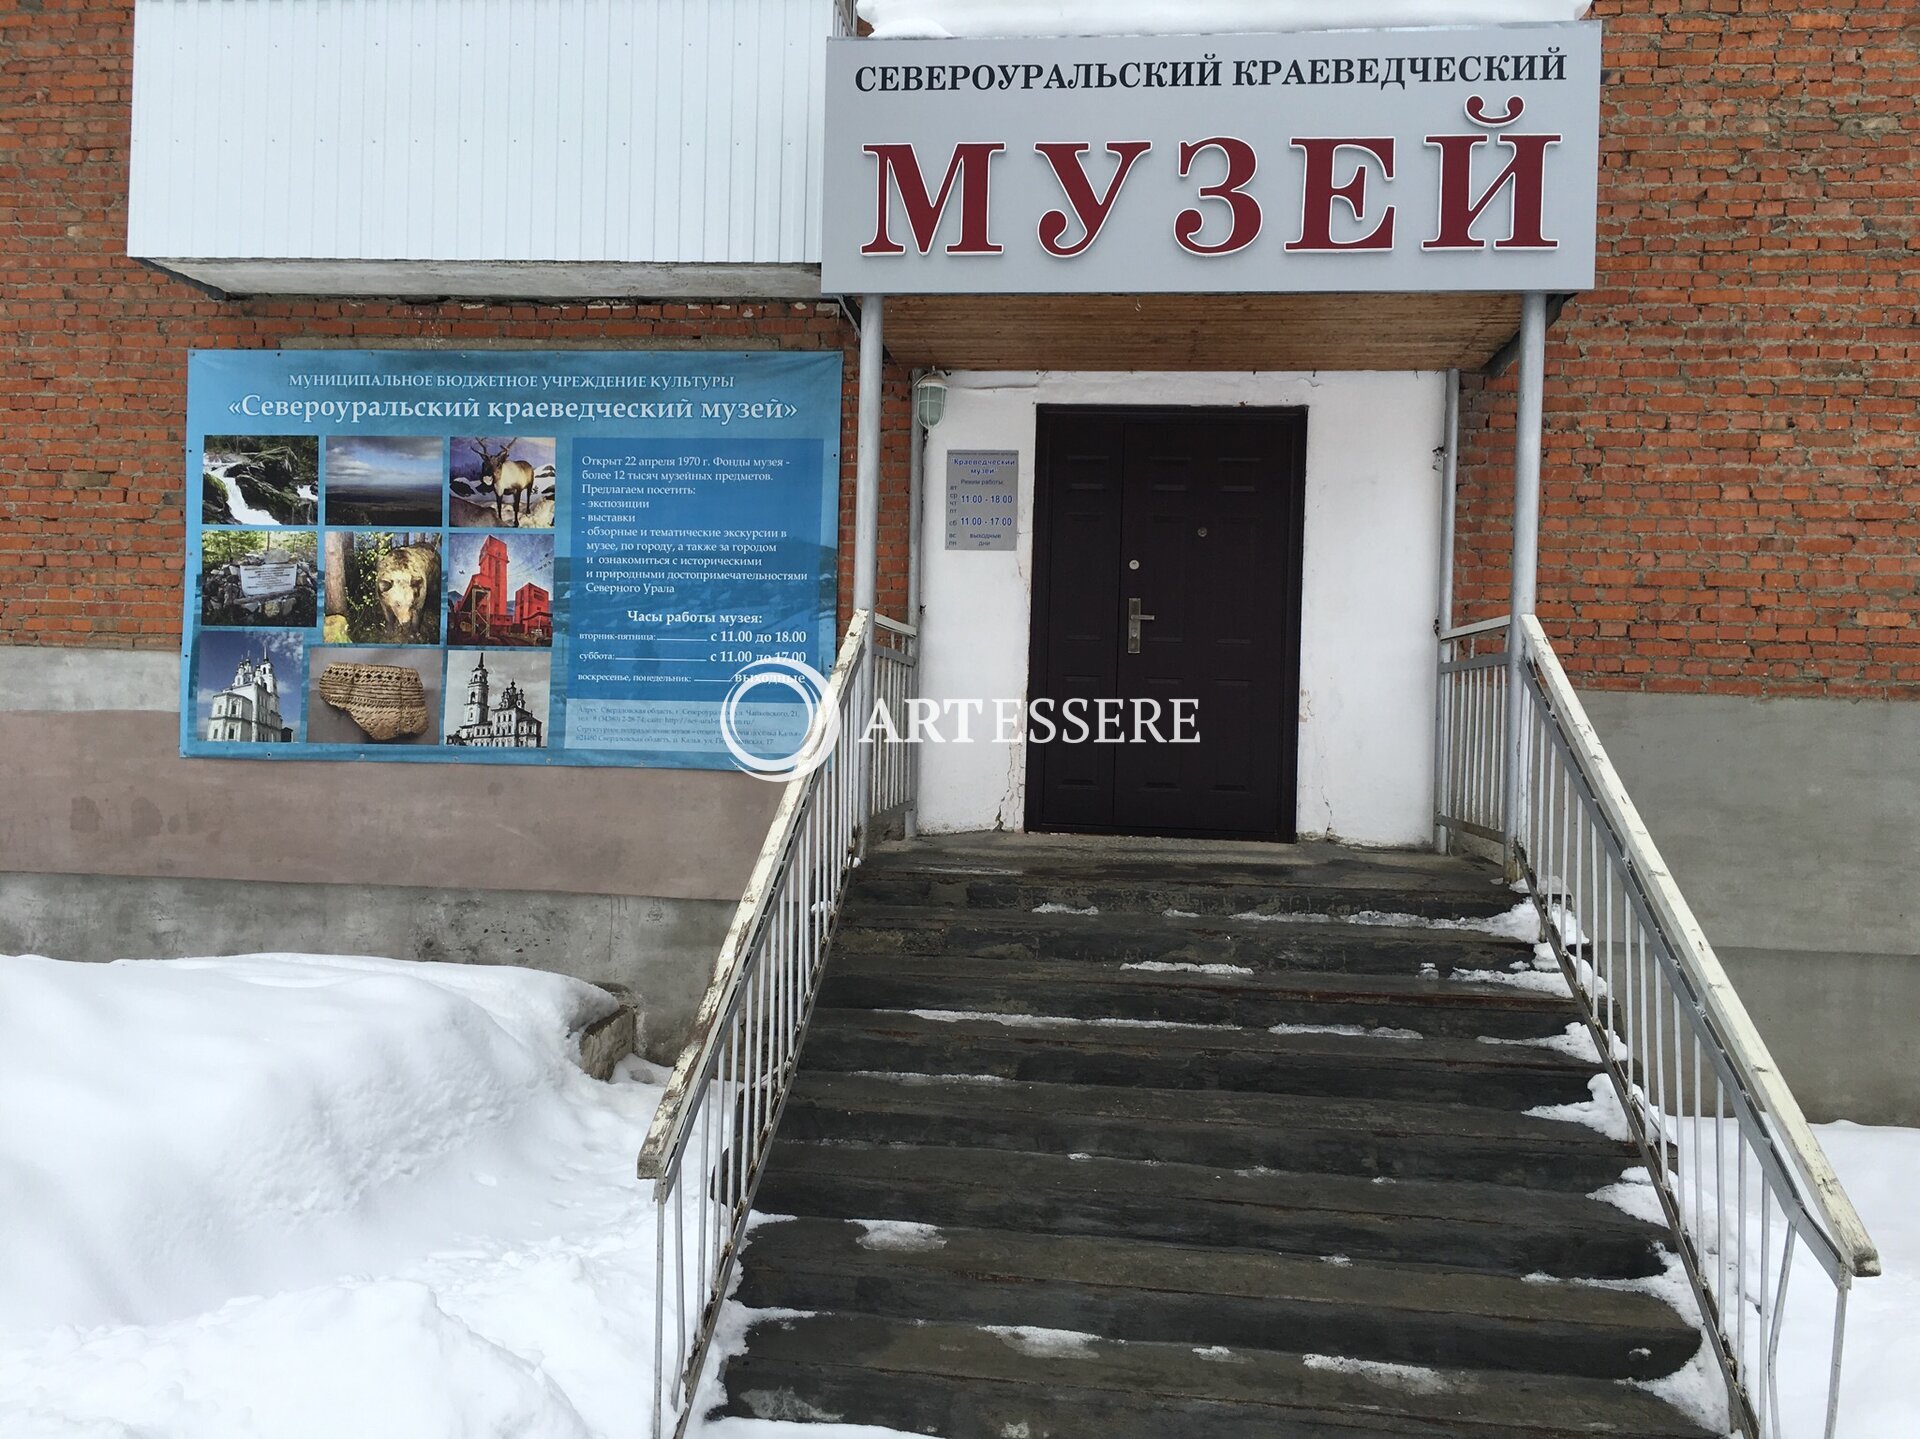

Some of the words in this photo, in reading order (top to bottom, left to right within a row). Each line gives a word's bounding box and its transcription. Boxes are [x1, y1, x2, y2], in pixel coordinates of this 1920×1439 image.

[854, 52, 1222, 93] СЕВЕРОУРАЛЬСКИЙ
[1232, 47, 1568, 90] КРАЕВЕДЧЕСКИЙ
[860, 94, 1563, 258] МУЗЕЙ
[289, 374, 433, 389] МУНИЦИПАЛЬНОЕ
[437, 374, 538, 389] БЮДЖЕТНОЕ
[542, 374, 647, 389] УЧРЕЖДЕНИЕ
[650, 374, 734, 389] КУЛЬТУРЫ
[227, 394, 480, 421] «Североуральский
[487, 398, 695, 423] краеведческий
[700, 398, 798, 424] музей»
[582, 457, 622, 468] Открыт
[625, 457, 636, 466] 22
[639, 459, 675, 469] апреля
[679, 457, 700, 466] 1970
[713, 457, 750, 468] Фонды
[753, 459, 783, 469] музея
[582, 471, 611, 480] более
[614, 471, 625, 480] 12
[628, 473, 658, 481] тысяч
[661, 471, 712, 483] музейных
[715, 473, 773, 483] предметов.
[582, 485, 644, 496] Предлагаем
[647, 487, 695, 495] посетить:
[588, 500, 649, 510] экспозиции
[588, 514, 635, 522] выставки
[587, 527, 637, 538] обзорные
[724, 530, 778, 539] экскурсии
[587, 544, 618, 553] музее,
[636, 544, 675, 553] городу,
[732, 545, 777, 554] городом
[599, 557, 669, 565] ознакомиться
[681, 558, 762, 567] историческими
[596, 571, 664, 581] природными
[667, 571, 808, 582] достопримечательностями
[586, 584, 640, 594] Северного
[644, 584, 675, 595] Урала
[628, 611, 662, 621] Часы
[666, 611, 716, 625] работы
[719, 615, 762, 626] музея:
[579, 633, 656, 642] вторник-пятница:
[711, 634, 717, 642] с
[720, 631, 753, 642] 11.00
[755, 634, 772, 644] до
[775, 632, 806, 642] 18.00
[579, 653, 615, 662] суббота:
[710, 654, 717, 662] с
[720, 651, 752, 663] 11.00
[775, 652, 806, 663] 17.00
[578, 673, 631, 683] воскресенье,
[633, 674, 691, 682] понедельник:
